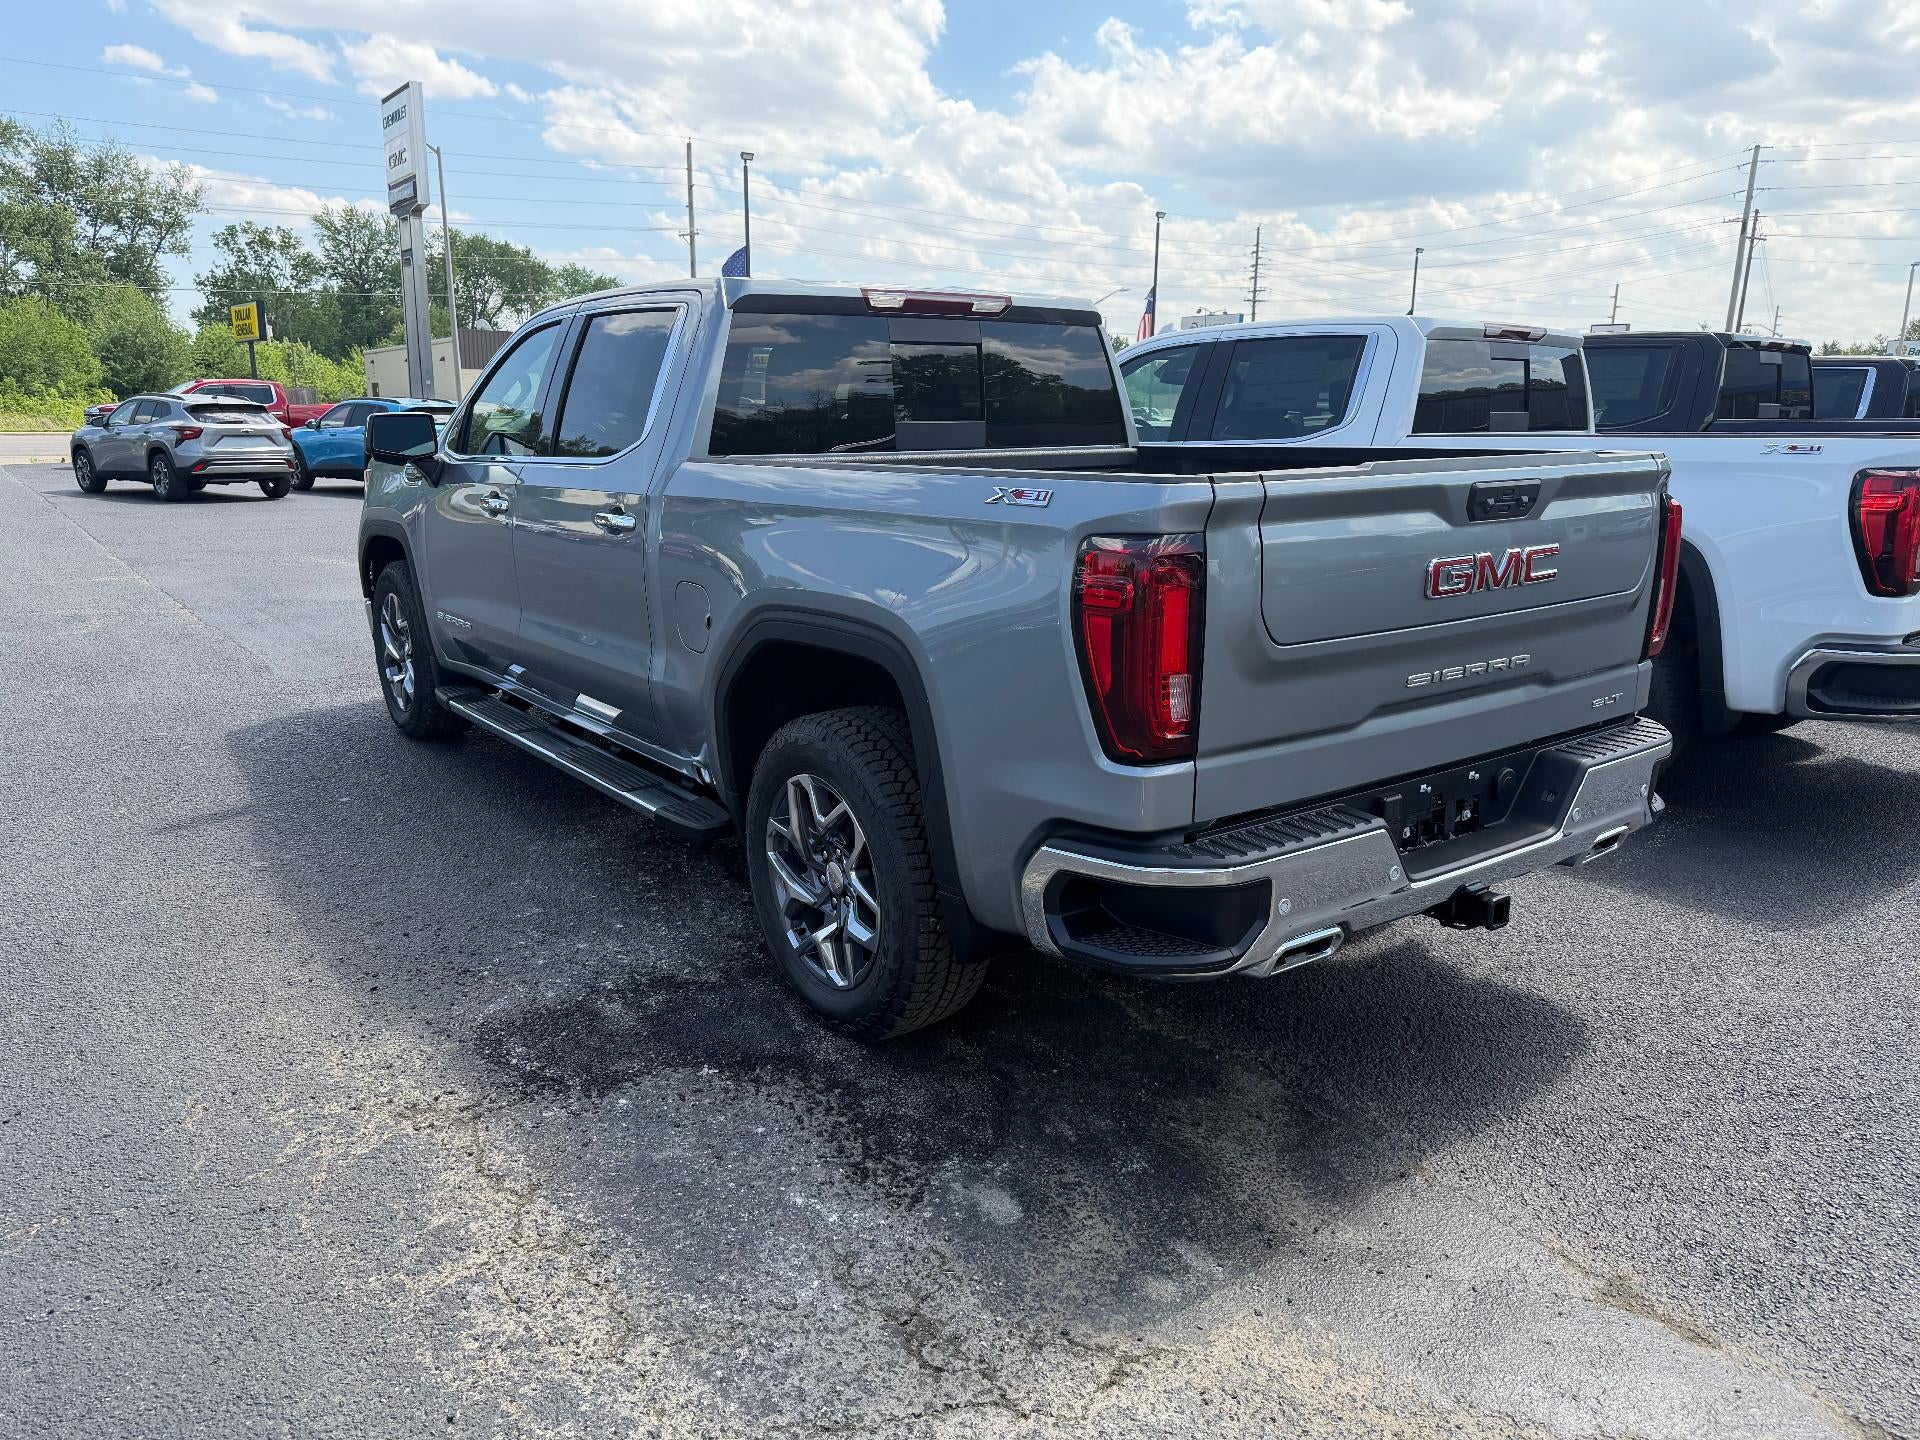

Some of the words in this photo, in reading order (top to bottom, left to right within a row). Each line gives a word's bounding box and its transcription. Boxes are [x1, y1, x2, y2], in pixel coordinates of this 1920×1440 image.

[388, 147, 407, 170] GMC
[234, 307, 252, 322] DOLLAR
[235, 322, 254, 337] GENERAL
[984, 486, 1053, 506] X31
[1424, 543, 1560, 599] GMC
[436, 611, 472, 631] SIERRA
[1406, 653, 1531, 688] SIERRA
[1591, 692, 1624, 709] SLT
